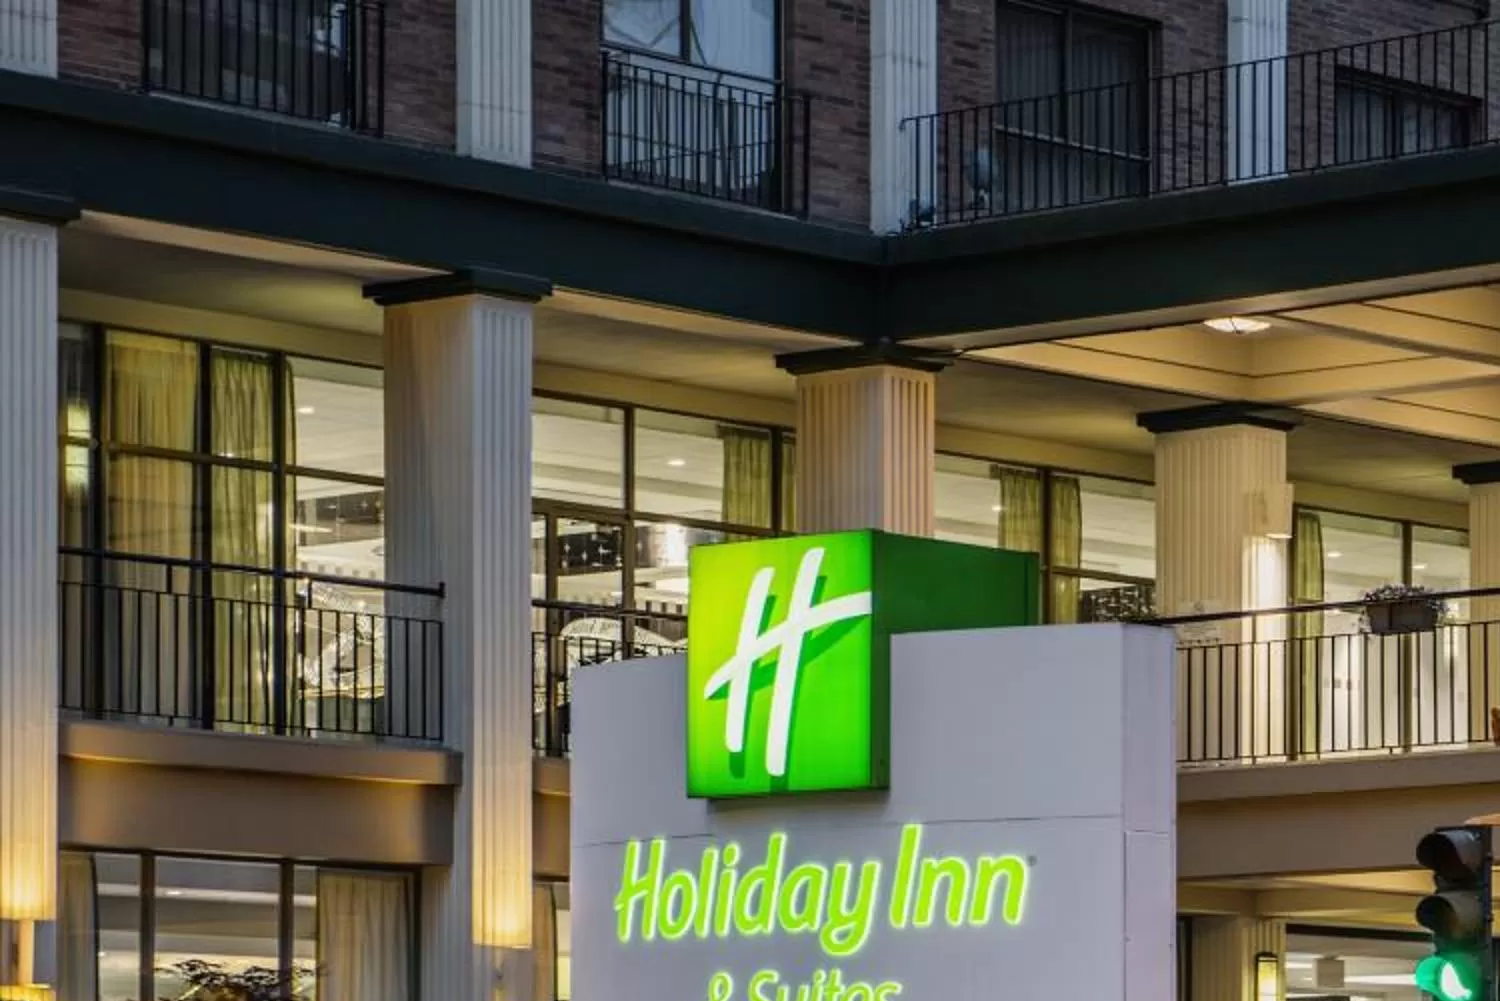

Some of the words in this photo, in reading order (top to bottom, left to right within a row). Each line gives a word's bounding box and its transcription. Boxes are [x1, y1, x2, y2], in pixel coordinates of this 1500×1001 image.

[703, 546, 872, 777] H
[614, 831, 879, 955] Holiday
[889, 823, 1027, 929] Inn
